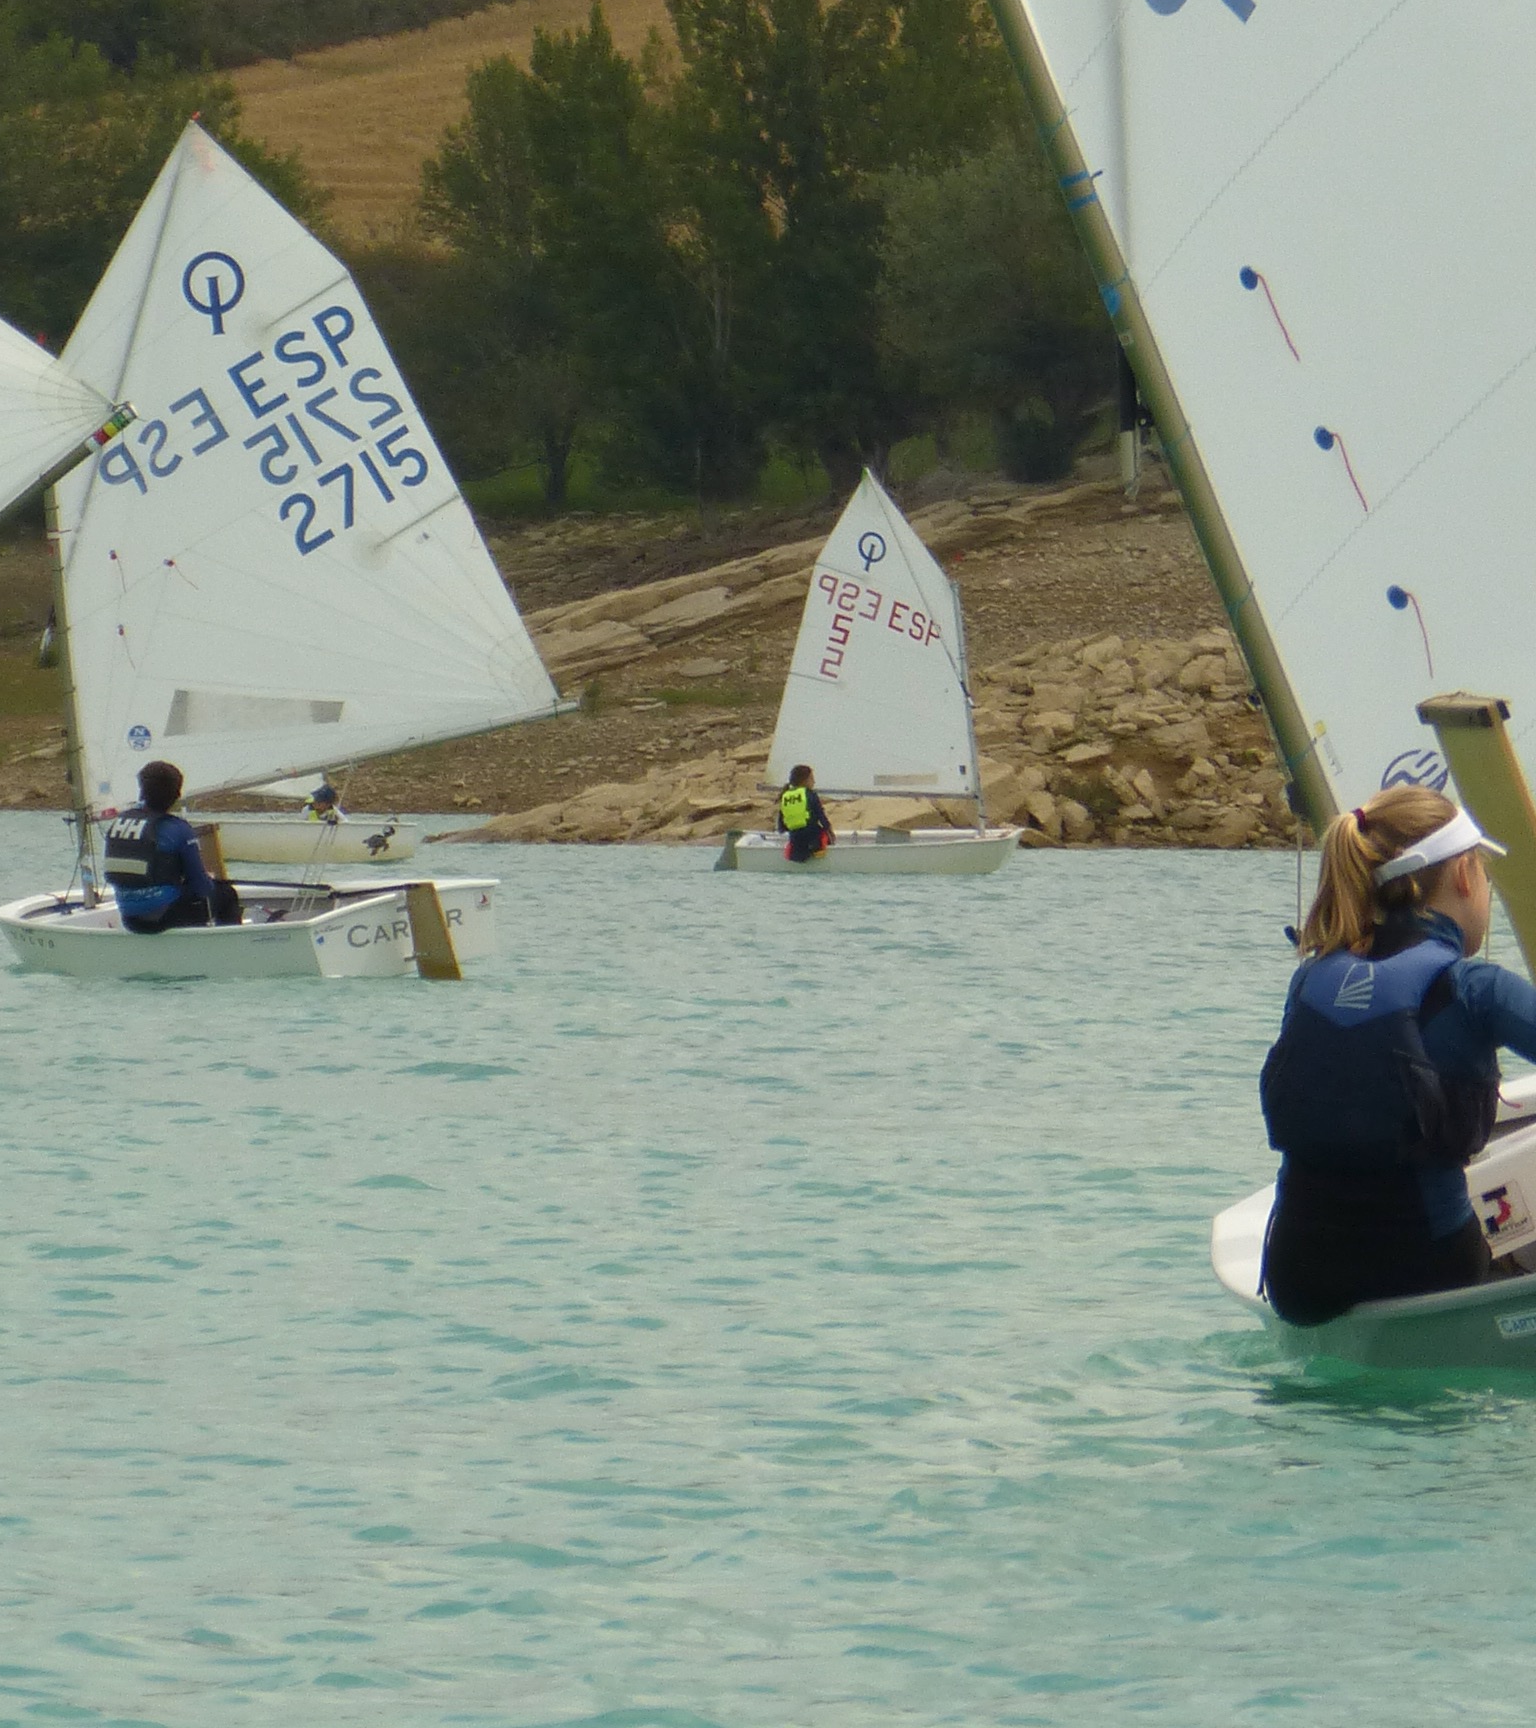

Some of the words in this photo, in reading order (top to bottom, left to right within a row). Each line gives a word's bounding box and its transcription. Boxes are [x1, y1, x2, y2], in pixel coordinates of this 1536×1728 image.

[227, 305, 356, 418] ESP
[279, 425, 429, 556] 2715
[888, 600, 942, 646] ESP
[784, 794, 802, 806] HH
[110, 817, 147, 840] HH
